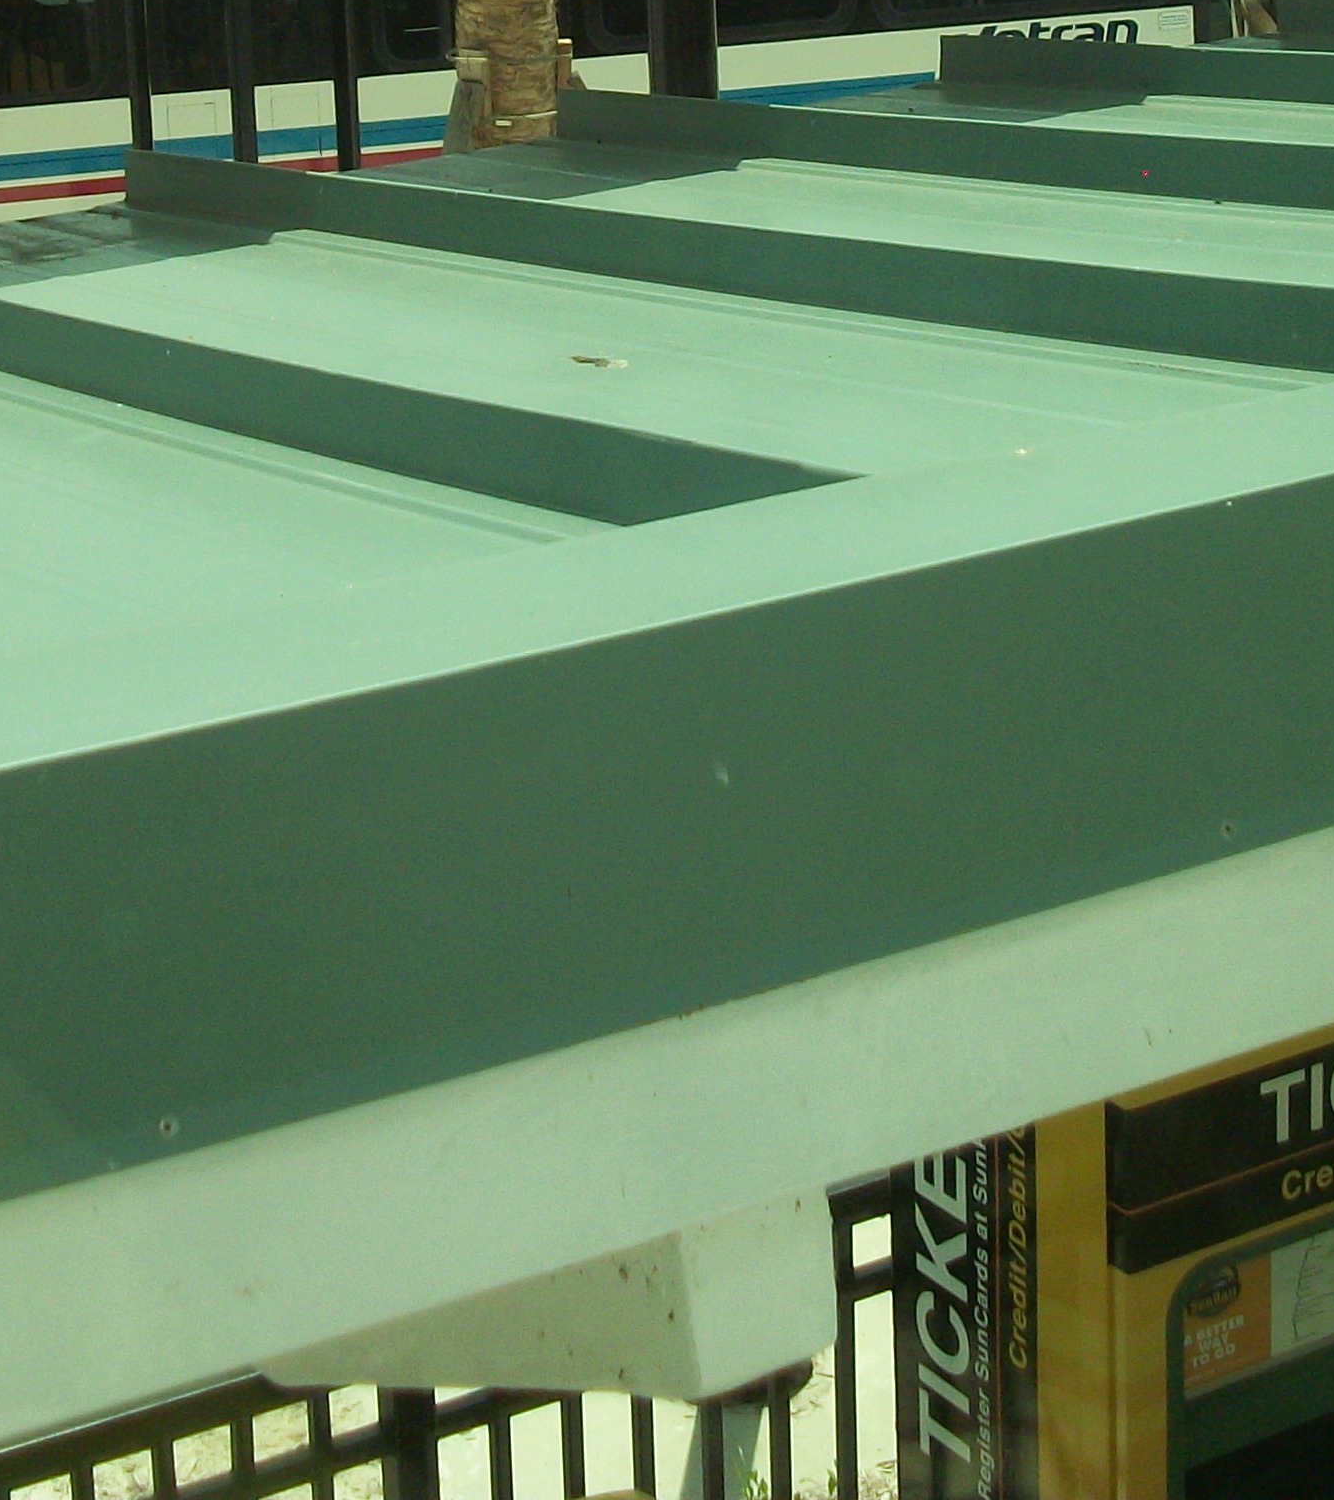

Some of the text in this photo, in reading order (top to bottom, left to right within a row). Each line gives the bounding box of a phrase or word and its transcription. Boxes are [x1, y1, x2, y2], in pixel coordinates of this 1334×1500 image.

[974, 1211, 988, 1241] at
[915, 1147, 970, 1463] TICKE
[973, 1251, 990, 1383] SunCards
[1196, 1314, 1245, 1341] BETTER
[1199, 1329, 1229, 1353] WAY
[1193, 1343, 1236, 1369] TO GO
[975, 1387, 995, 1500] Register
